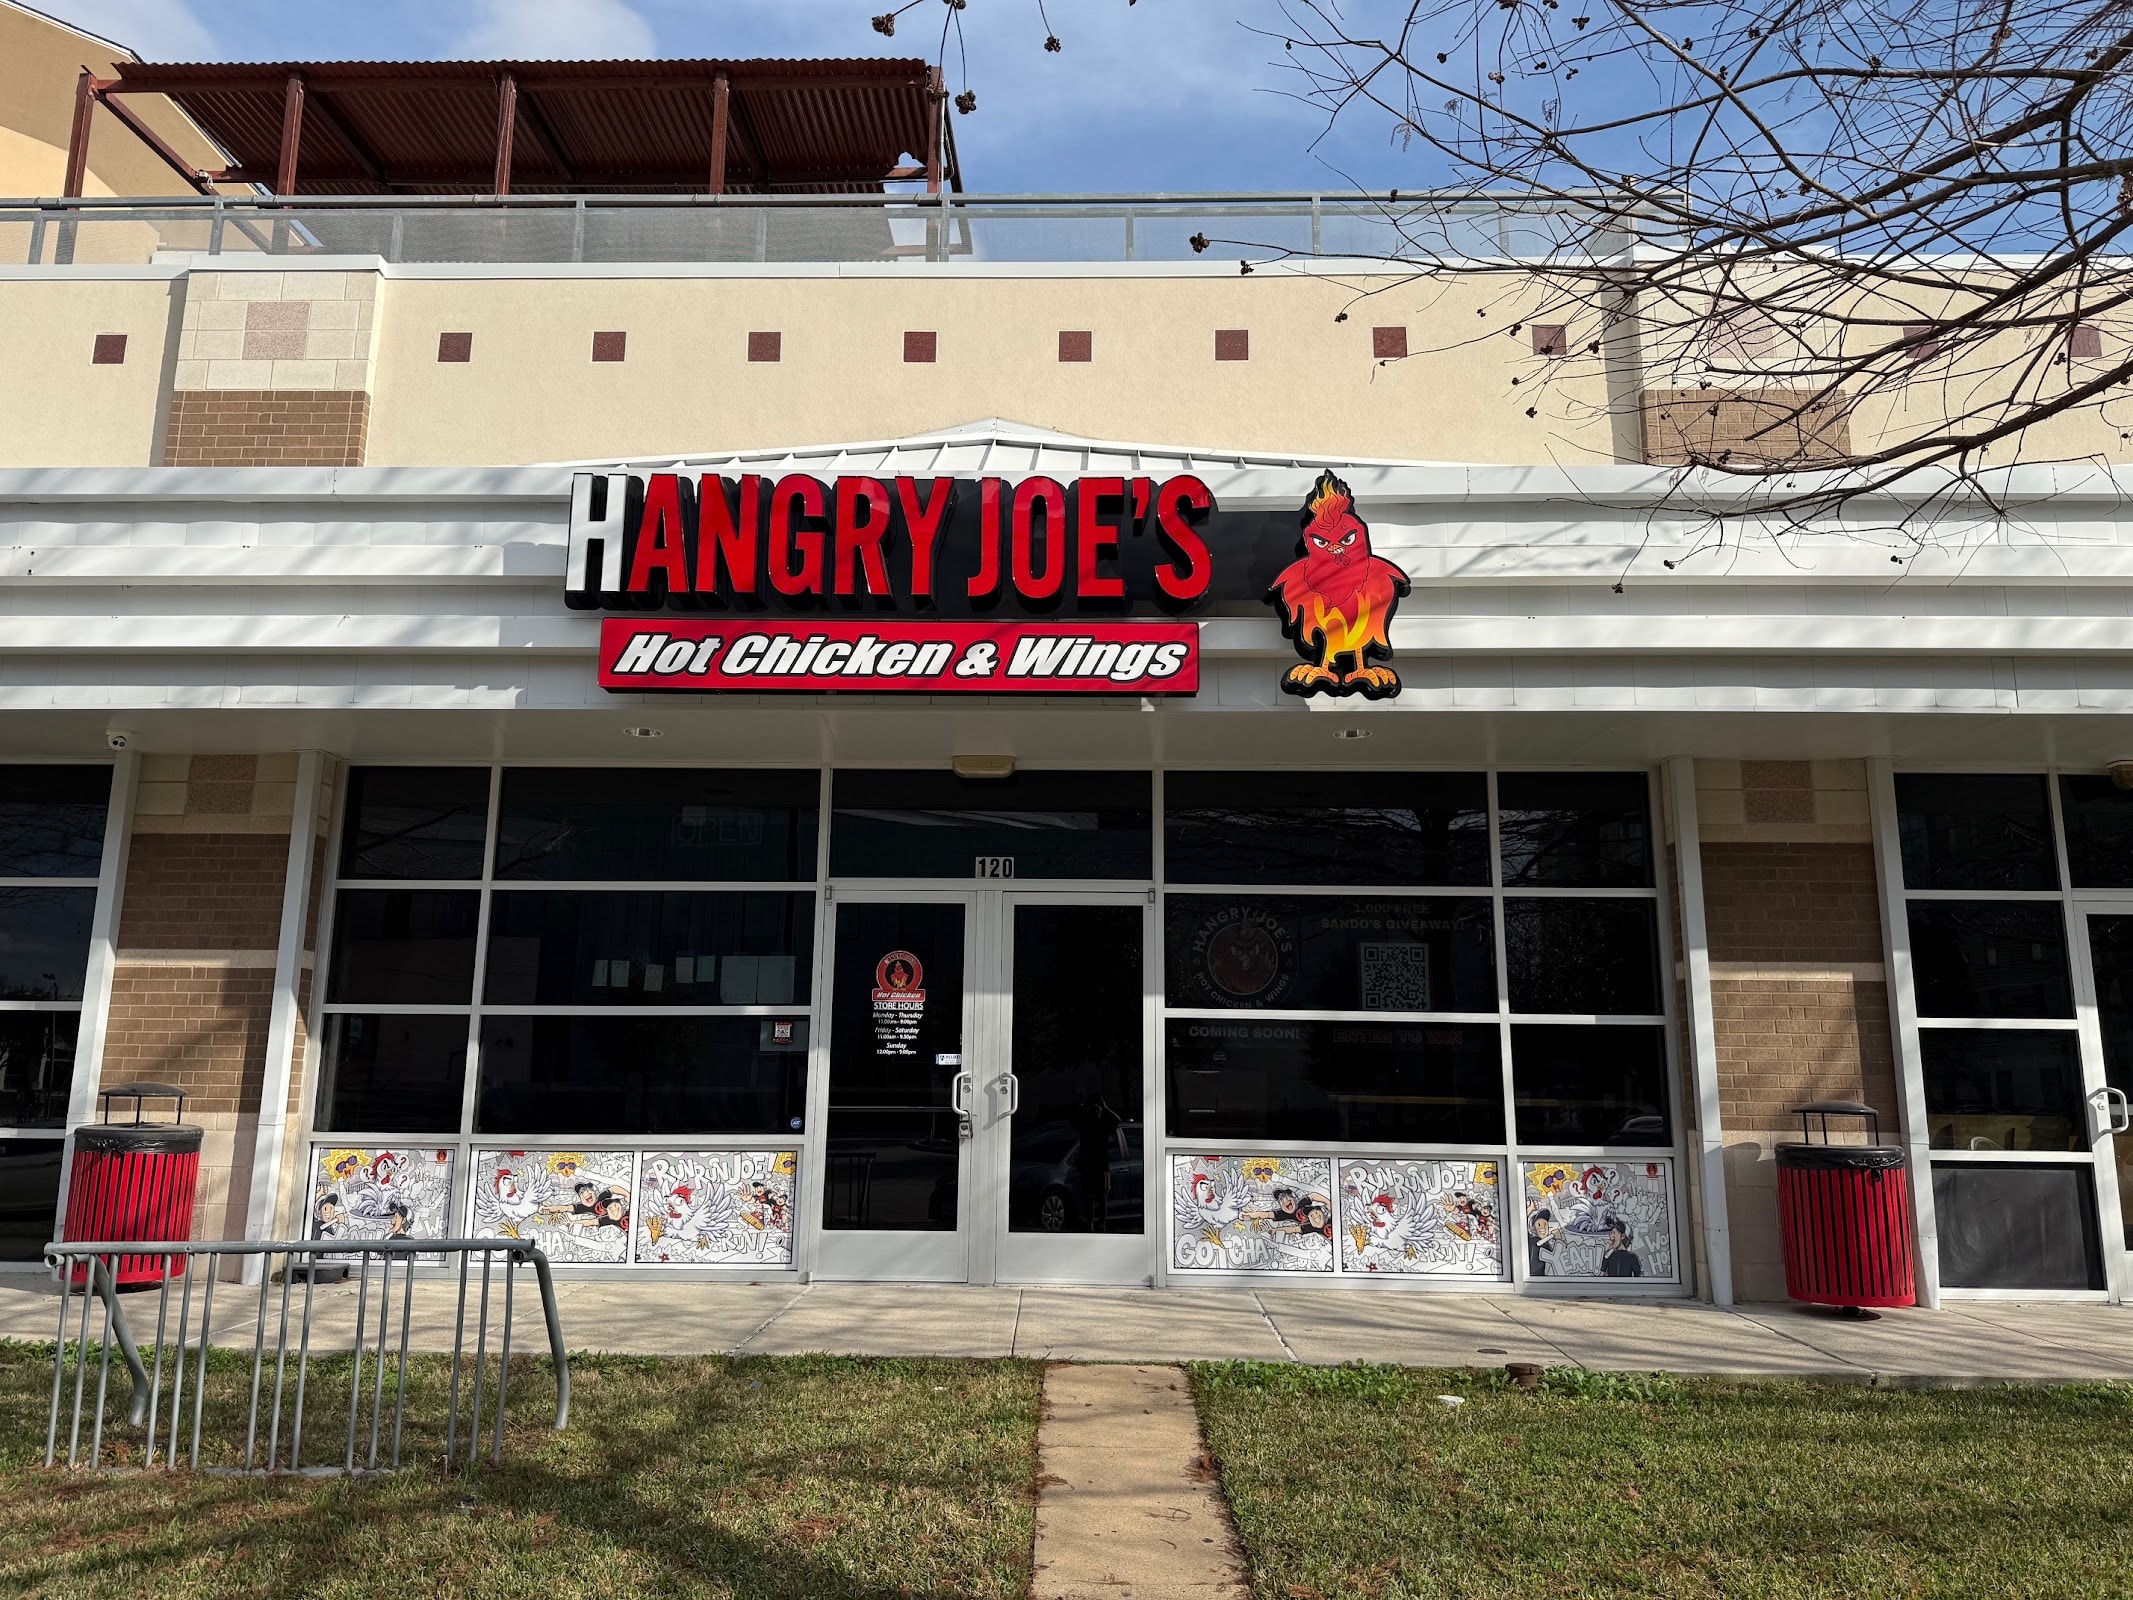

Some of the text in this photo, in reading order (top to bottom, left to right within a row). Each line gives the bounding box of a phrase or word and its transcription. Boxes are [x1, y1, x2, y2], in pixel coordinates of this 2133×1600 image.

[567, 473, 1214, 599] HANGRY JOE'S
[613, 633, 1188, 682] Hot Chicken & Wings
[678, 816, 758, 842] OPEN
[978, 858, 1013, 878] 120
[1353, 903, 1432, 915] 1,000 FREE
[1192, 906, 1293, 953] HANGRY JOE'S
[1320, 918, 1382, 930] SANDO'S
[1264, 973, 1290, 1003] WINGS
[872, 1011, 895, 1019] Monday
[898, 1011, 924, 1020] Thursday
[873, 1002, 924, 1010] STORE HOURS
[886, 1042, 907, 1050] Sunday
[1188, 1025, 1300, 1040] COMING SOON!
[1333, 1028, 1464, 1045] ENTER TO WIN
[652, 1153, 778, 1190] RUN RUN JOE!
[1350, 1161, 1477, 1199] RUN RUN JOE!
[721, 1230, 769, 1260] RUN!
[1426, 1242, 1476, 1271] RUN!
[1539, 1240, 1605, 1277] YEAH!
